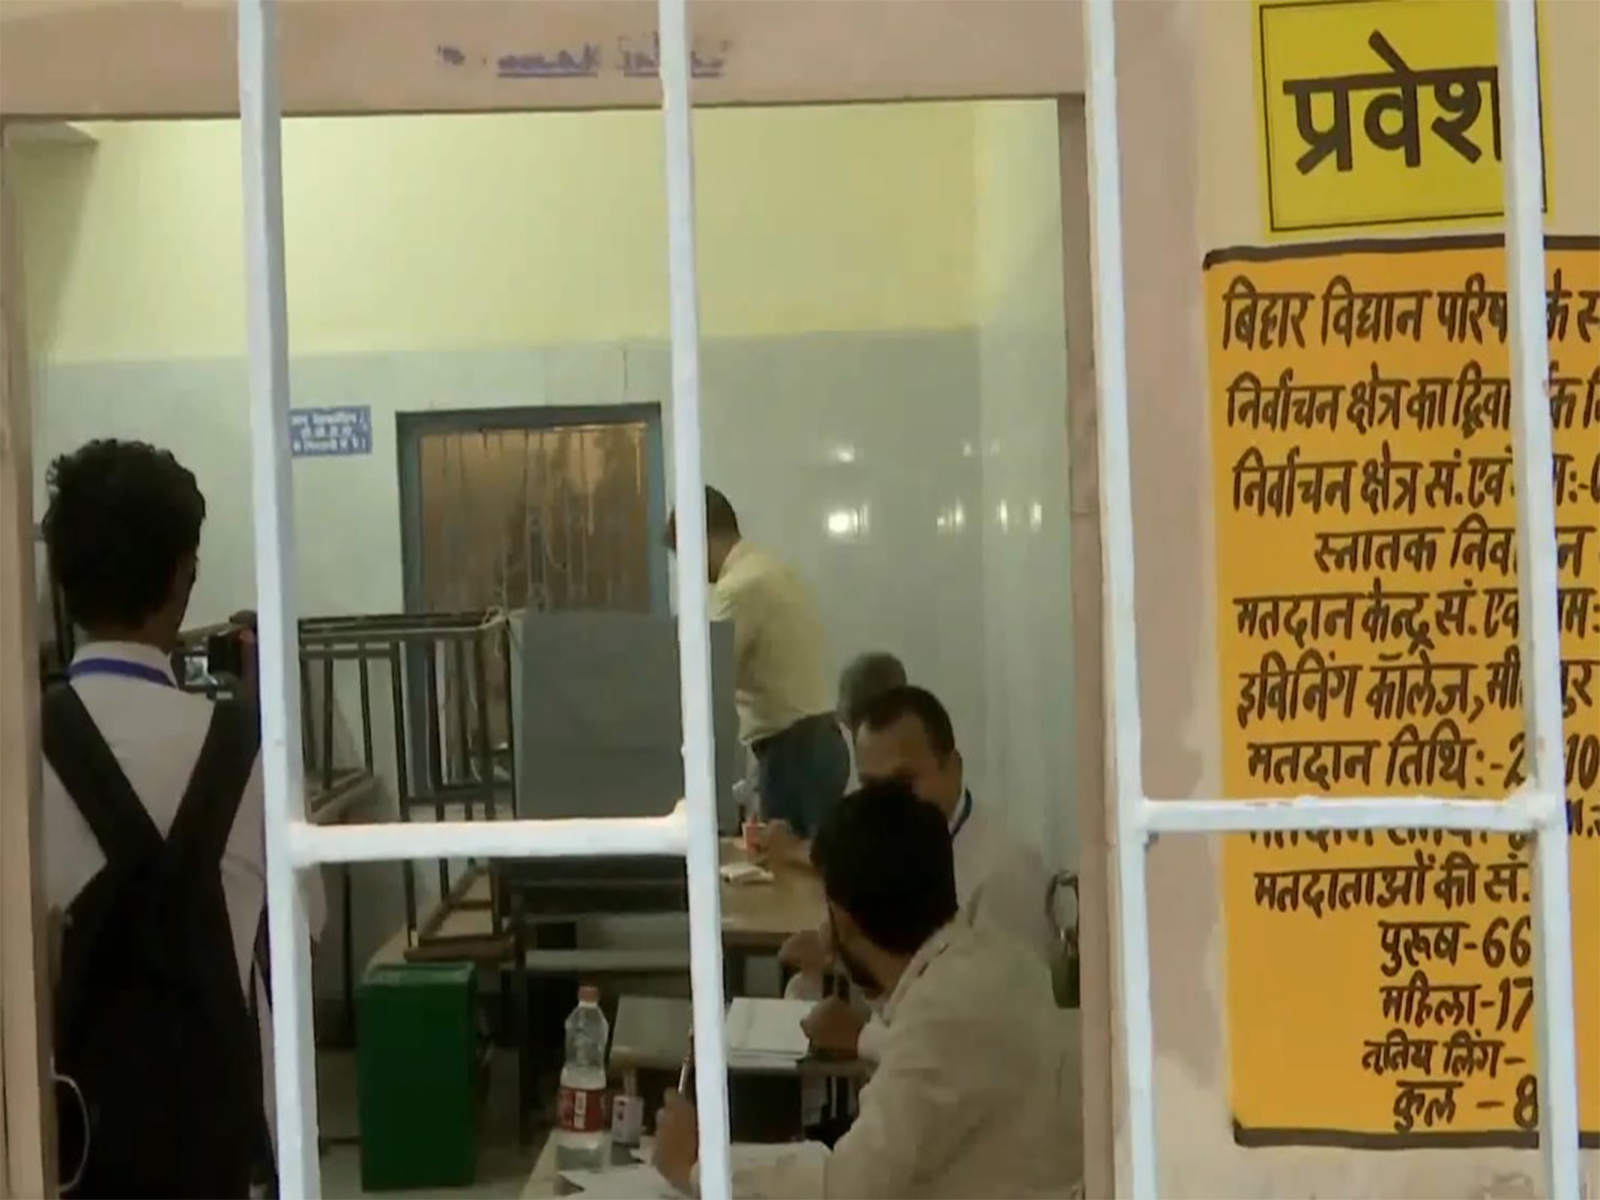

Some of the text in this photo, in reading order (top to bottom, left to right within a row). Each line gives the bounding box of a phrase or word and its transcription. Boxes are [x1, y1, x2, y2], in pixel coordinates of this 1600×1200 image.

[1282, 28, 1502, 176] प्रवेश
[1222, 274, 1315, 350] बिहार
[1226, 366, 1345, 434] निर्वाचन
[1348, 360, 1410, 436] क्षेत्र
[1406, 377, 1453, 432] का
[1232, 446, 1357, 518] निर्वाचन
[1362, 440, 1422, 516] क्षेत्र
[1314, 526, 1444, 574] स्नातक
[1232, 592, 1364, 648] मतदान
[1362, 577, 1432, 655] केन्द्र
[1238, 647, 1362, 728] इविनिंग
[1247, 740, 1380, 790] मतदान
[1254, 850, 1434, 918] मतदाताओं
[1434, 852, 1480, 910] की
[1394, 1082, 1464, 1132] कुल
